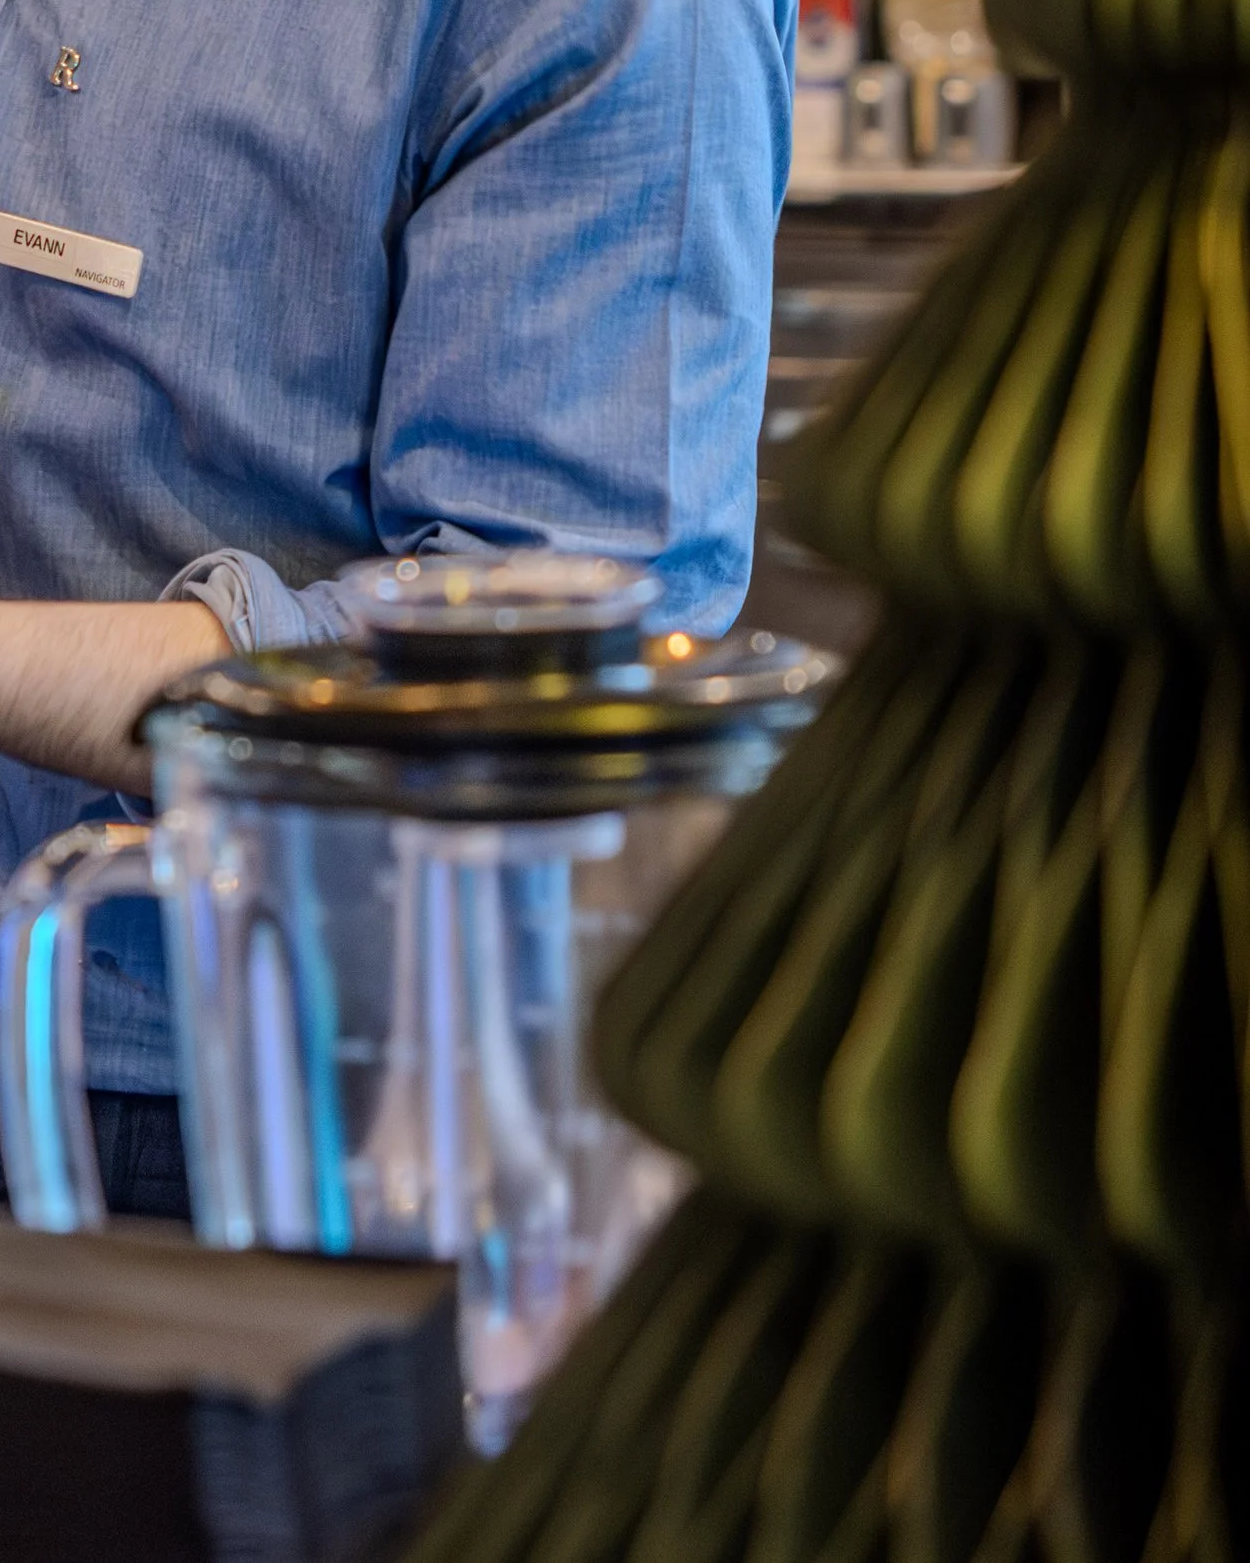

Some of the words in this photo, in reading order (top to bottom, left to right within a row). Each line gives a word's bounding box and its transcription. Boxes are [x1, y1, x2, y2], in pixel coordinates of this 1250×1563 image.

[51, 46, 81, 91] R
[13, 228, 66, 257] EVANN
[74, 267, 126, 289] NAVIGATOR
